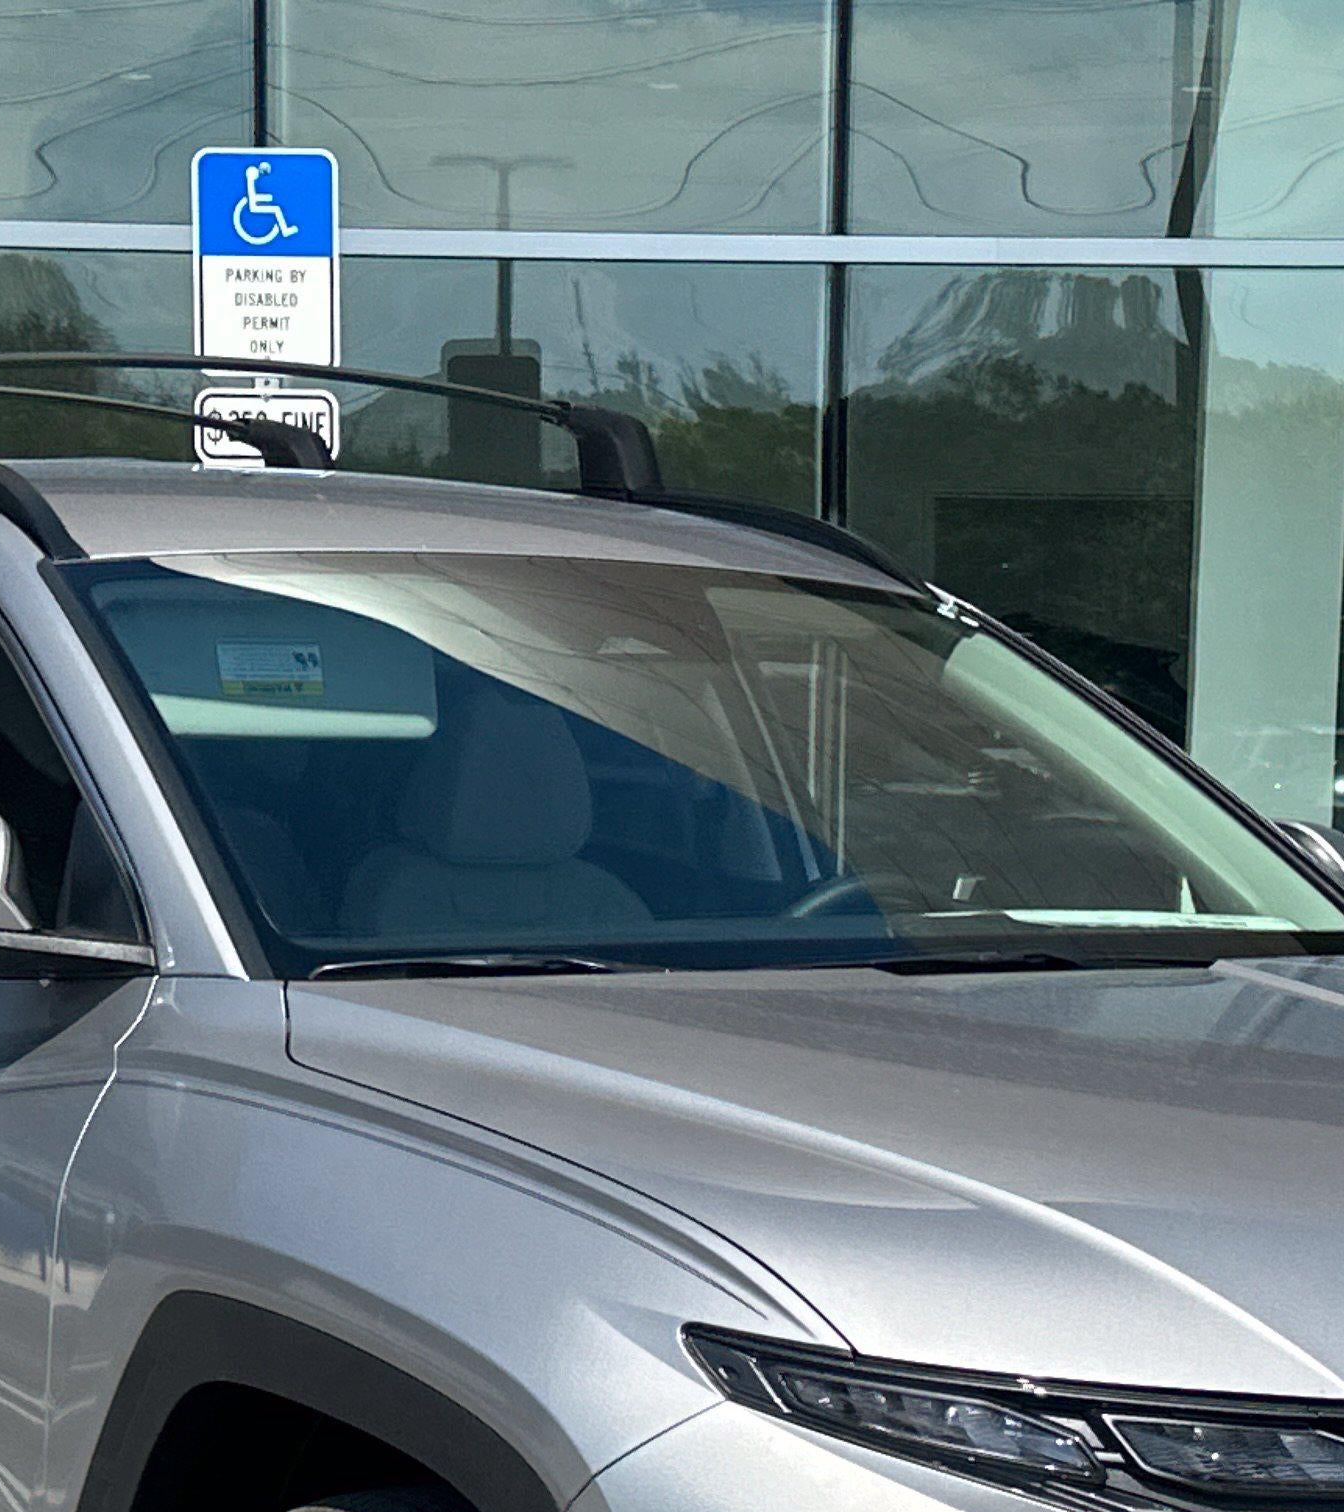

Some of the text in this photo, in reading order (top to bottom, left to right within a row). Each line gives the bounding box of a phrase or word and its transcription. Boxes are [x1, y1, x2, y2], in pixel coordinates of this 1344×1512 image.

[225, 267, 306, 283] PARKING BY
[234, 292, 298, 307] DISABLED
[242, 316, 290, 331] PERMIT
[250, 340, 284, 353] ONLY
